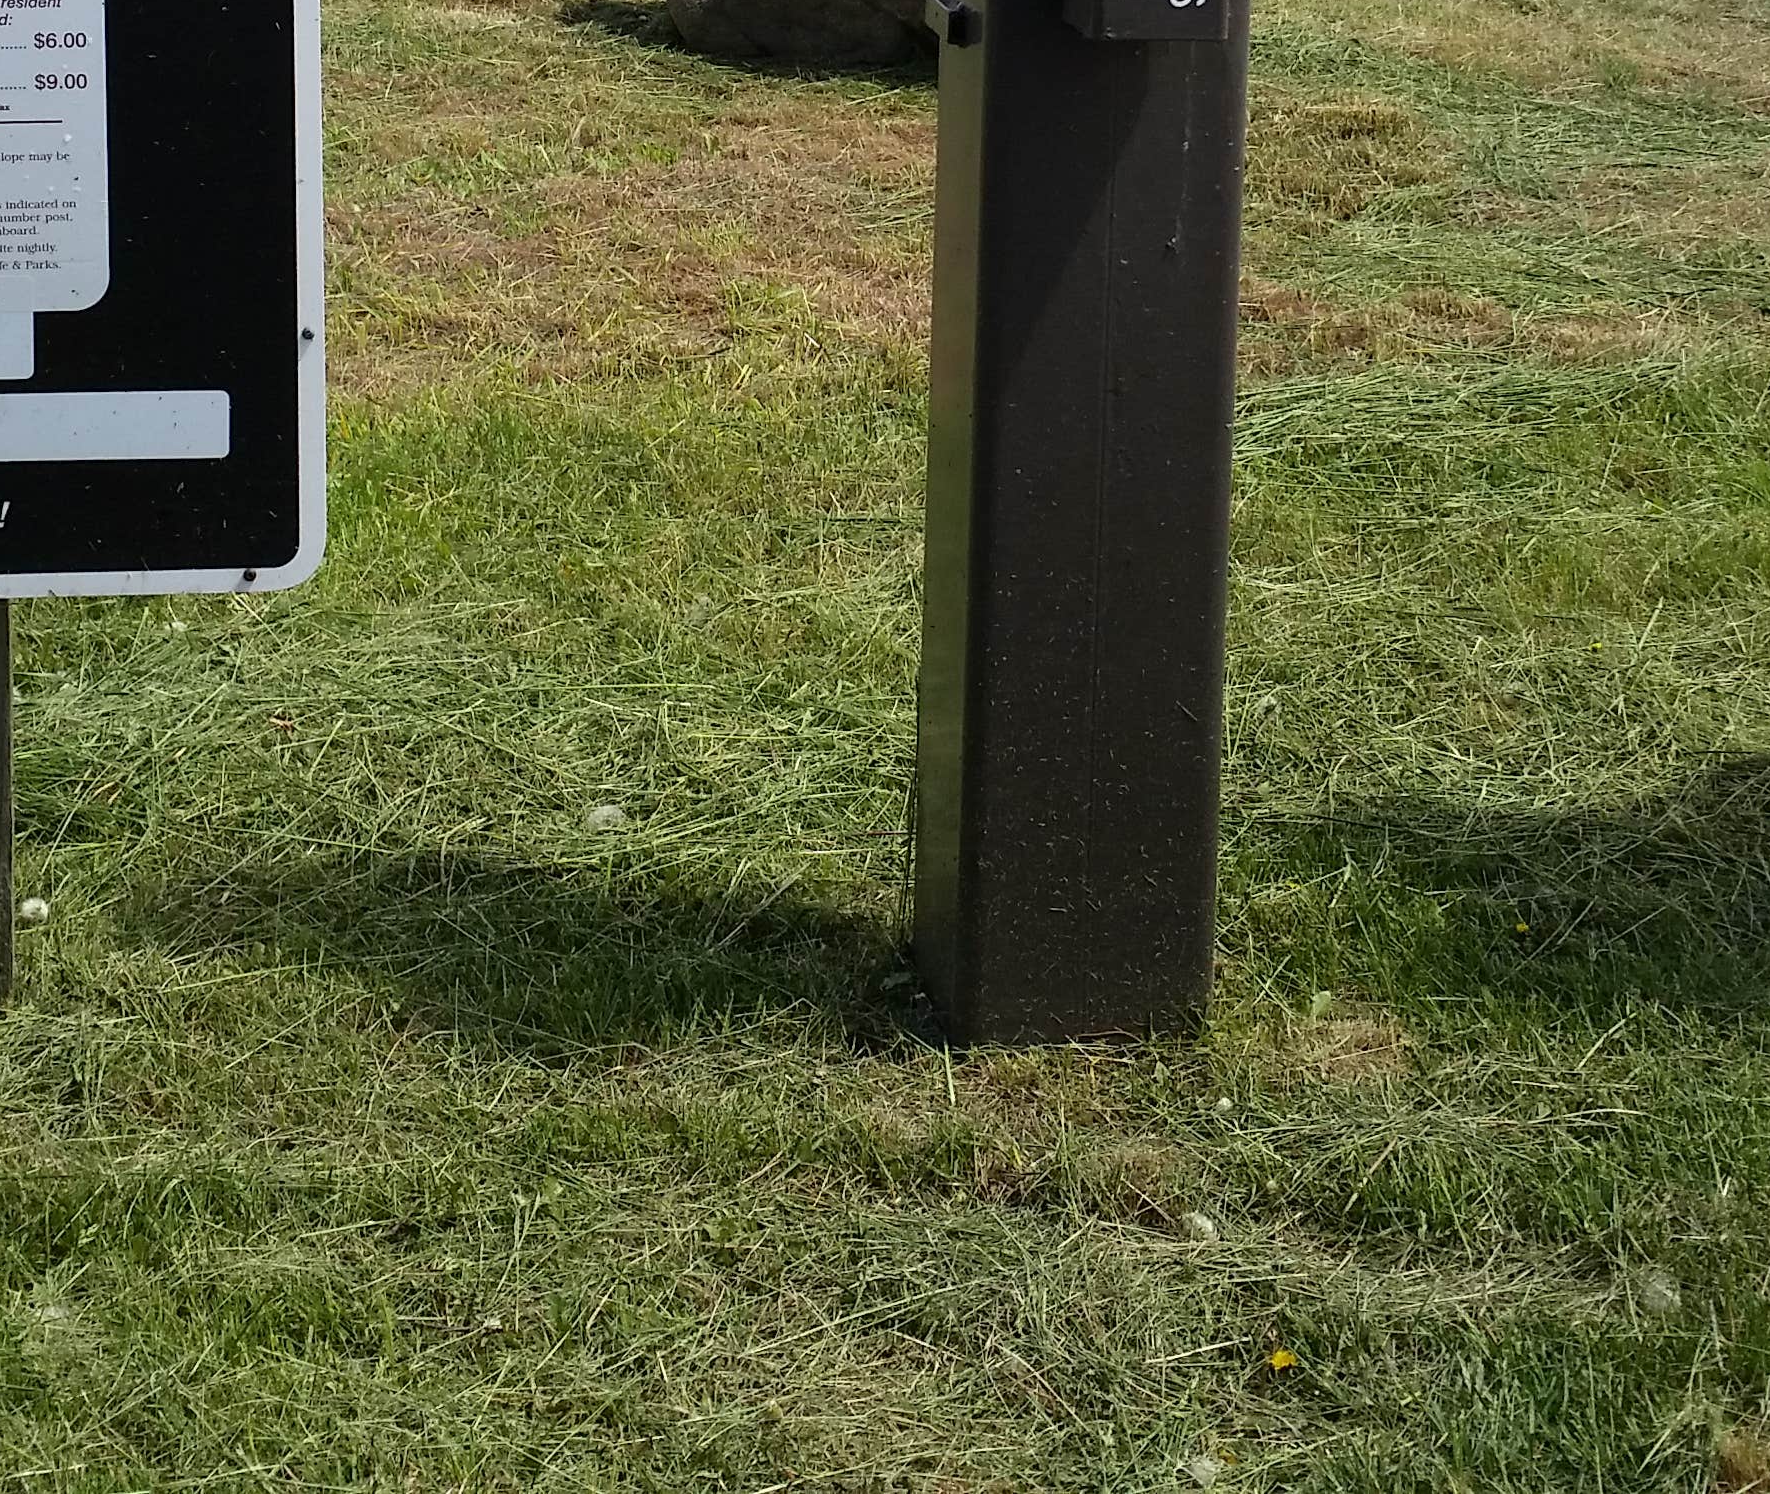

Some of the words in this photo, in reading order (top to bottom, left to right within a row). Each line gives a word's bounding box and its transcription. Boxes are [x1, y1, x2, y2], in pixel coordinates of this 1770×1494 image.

[33, 31, 87, 50] $6.00
[33, 73, 88, 92] $9.00
[28, 153, 53, 164] may
[56, 150, 71, 163] be
[11, 260, 22, 271] &
